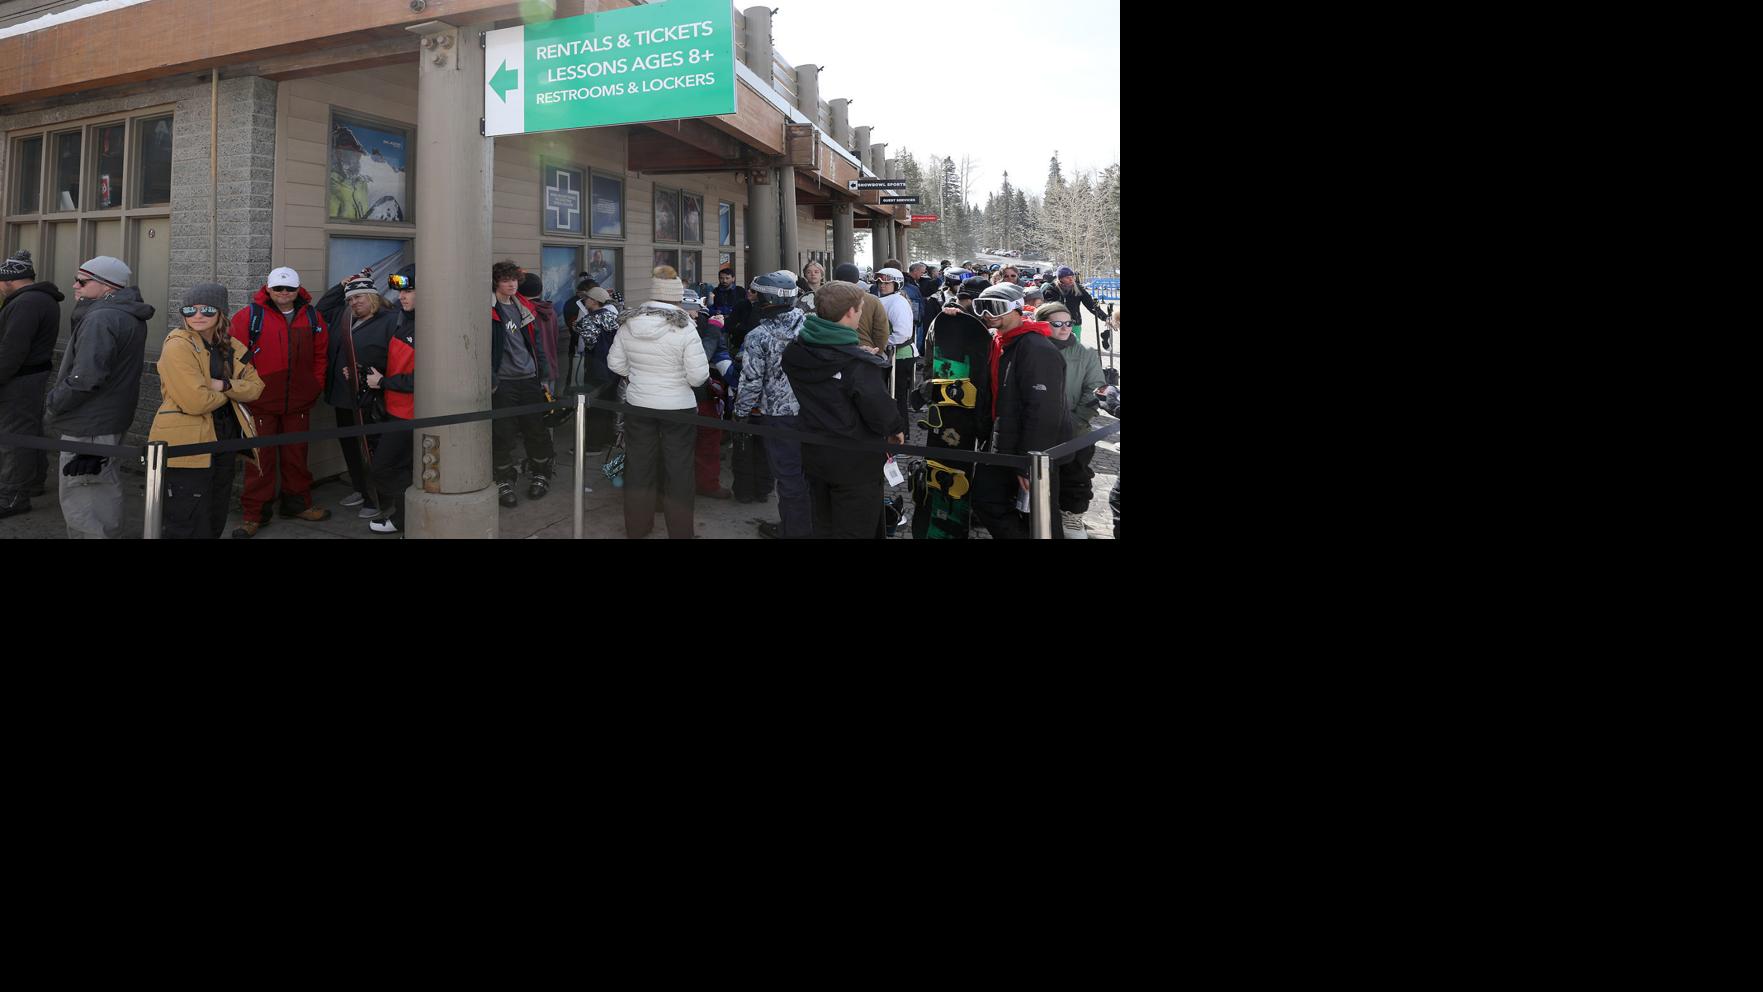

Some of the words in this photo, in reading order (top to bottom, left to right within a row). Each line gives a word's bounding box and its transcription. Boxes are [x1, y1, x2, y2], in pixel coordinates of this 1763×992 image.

[536, 35, 613, 61] RENTALS
[616, 33, 632, 49] &
[634, 20, 714, 46] TICKETS
[547, 58, 628, 83] LESSONS
[631, 50, 684, 72] AGES
[688, 48, 715, 64] 8+
[535, 82, 624, 104] RESTROOMS
[627, 81, 639, 94] &
[642, 72, 715, 93] LOCKERS
